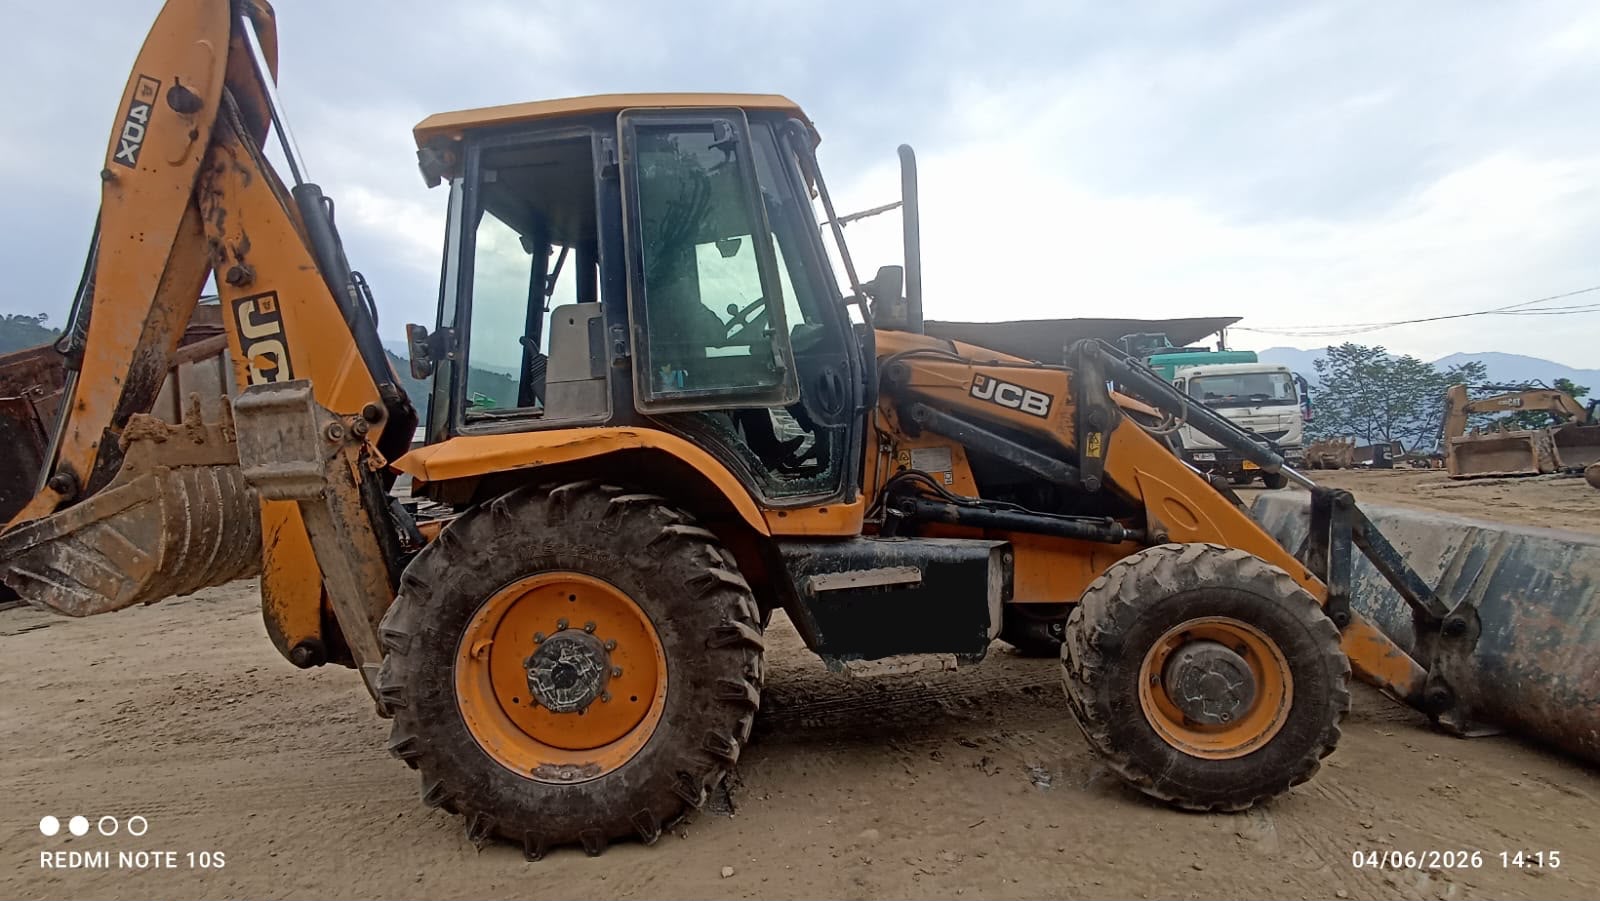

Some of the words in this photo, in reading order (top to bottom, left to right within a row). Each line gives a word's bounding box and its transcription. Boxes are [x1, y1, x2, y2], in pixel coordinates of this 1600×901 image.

[115, 104, 149, 164] 4DX
[238, 299, 290, 385] JC
[971, 378, 1050, 416] JCB
